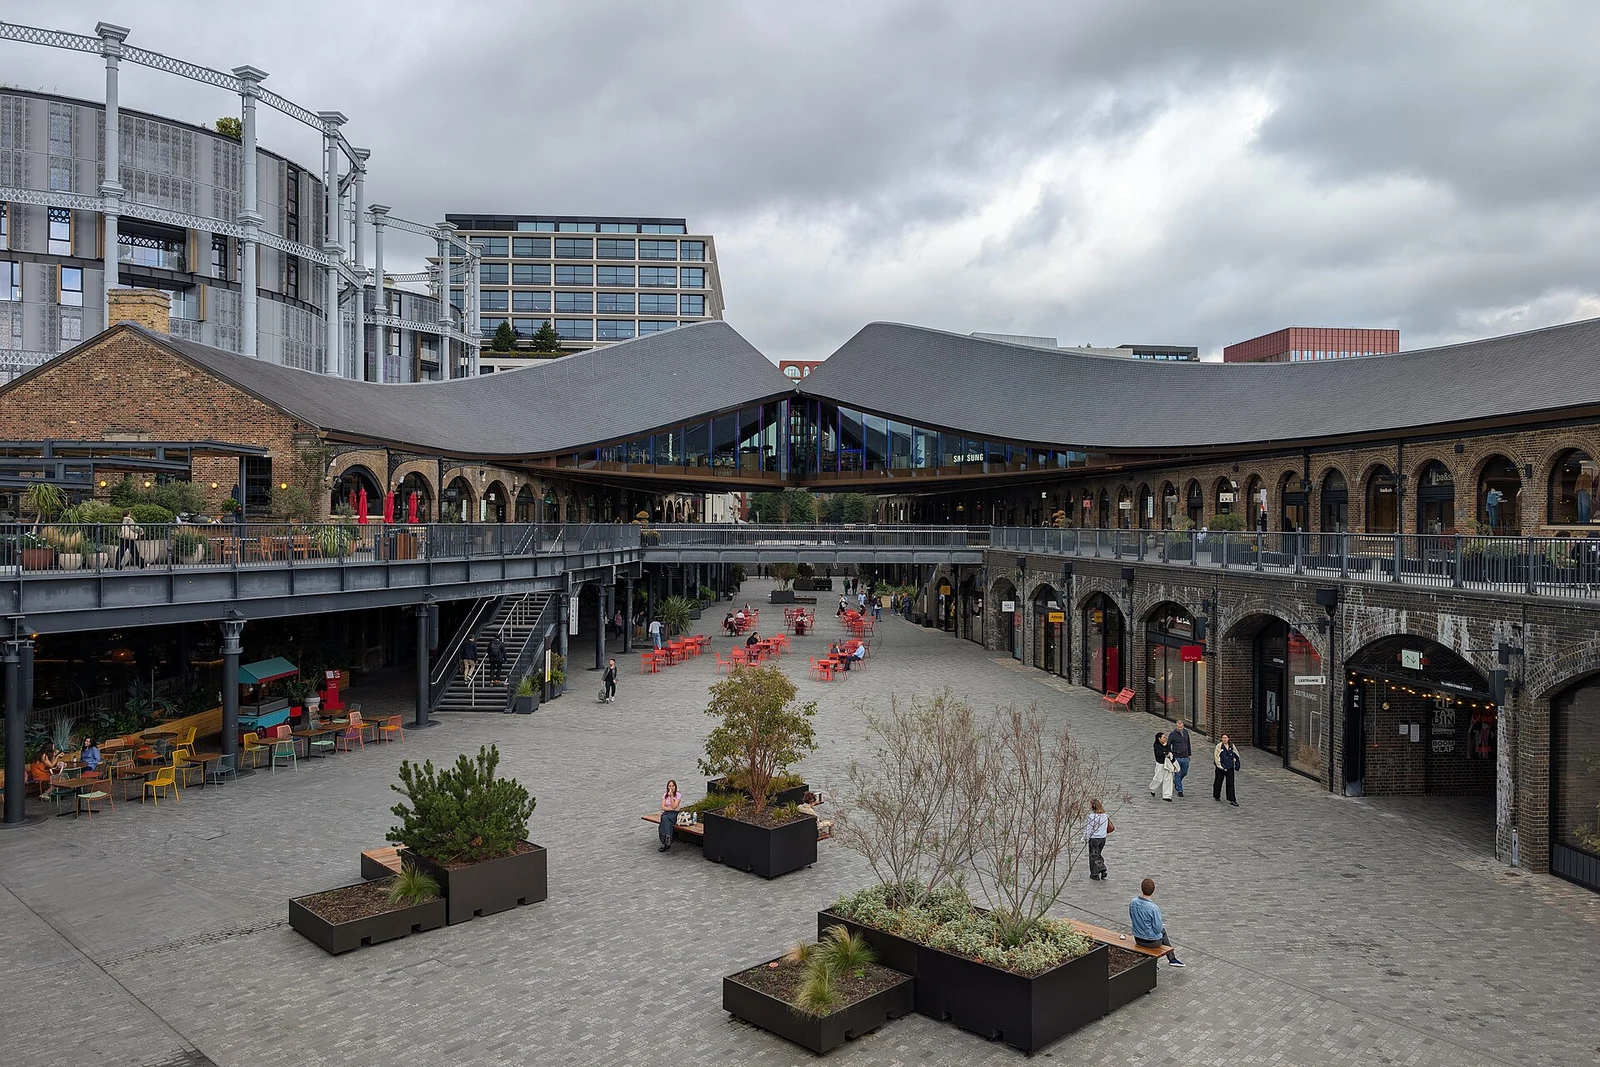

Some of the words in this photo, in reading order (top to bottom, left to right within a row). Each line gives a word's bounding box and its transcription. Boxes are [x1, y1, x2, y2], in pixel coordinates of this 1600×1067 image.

[1293, 689, 1318, 701] LESTRANGE
[1433, 699, 1454, 708] TIP
[1433, 715, 1455, 725] DIN
